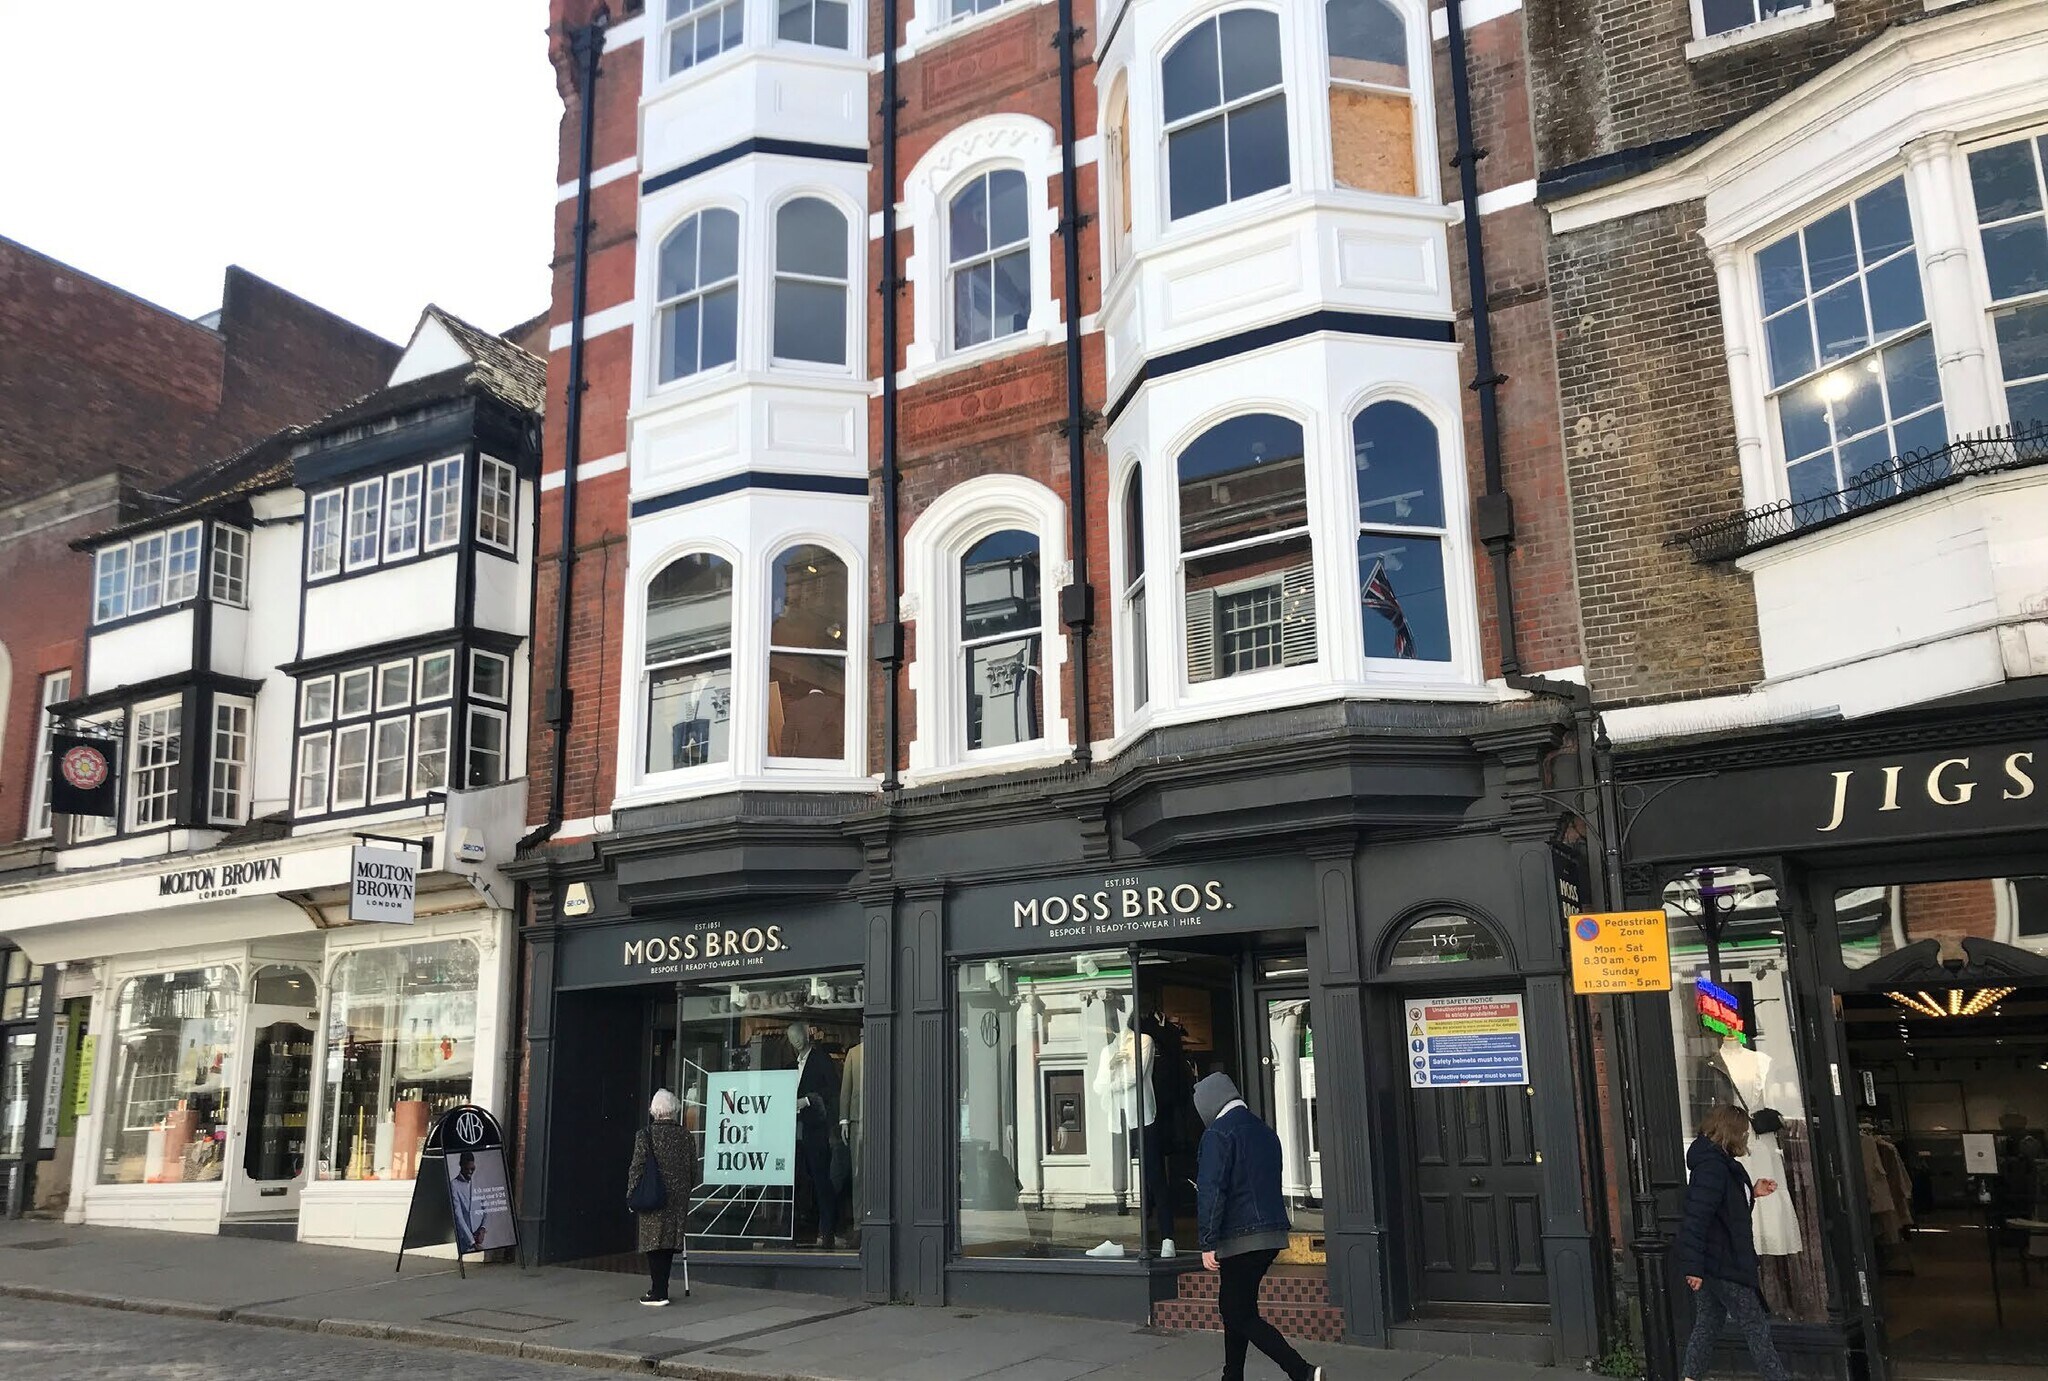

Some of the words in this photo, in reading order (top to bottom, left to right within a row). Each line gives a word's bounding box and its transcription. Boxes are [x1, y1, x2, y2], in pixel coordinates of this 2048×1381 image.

[1816, 751, 2035, 832] JIGS
[159, 867, 217, 896] MOLTON
[221, 857, 282, 887] BROWN
[357, 861, 413, 882] MOLTON
[356, 880, 413, 901] BROWN
[1105, 877, 1139, 888] EST.1851
[1560, 878, 1579, 903] MOSS
[199, 887, 238, 900] LONDON
[366, 900, 403, 909] LONDON
[1014, 891, 1111, 928] MOSS
[1122, 880, 1234, 918] BROS.
[1049, 926, 1086, 937] BESPOKE
[1096, 919, 1169, 933] READY-TO-WEAR
[1180, 917, 1201, 925] HIRE
[1605, 917, 1659, 927] Pedestrian
[1432, 934, 1458, 947] 156
[1620, 928, 1645, 937] Zone
[624, 933, 699, 966] MOSS
[705, 925, 790, 958] BROS.
[1594, 945, 1616, 954] Mon
[1626, 943, 1644, 952] Sat
[650, 965, 678, 974] BESPOKE
[685, 959, 740, 971] READY-TO-WEAR
[747, 956, 764, 965] HIRE
[1602, 967, 1640, 977] Sunday
[1470, 1010, 1497, 1018] prohibited
[719, 1091, 772, 1115] New
[718, 1118, 754, 1145] for
[717, 1151, 769, 1171] now
